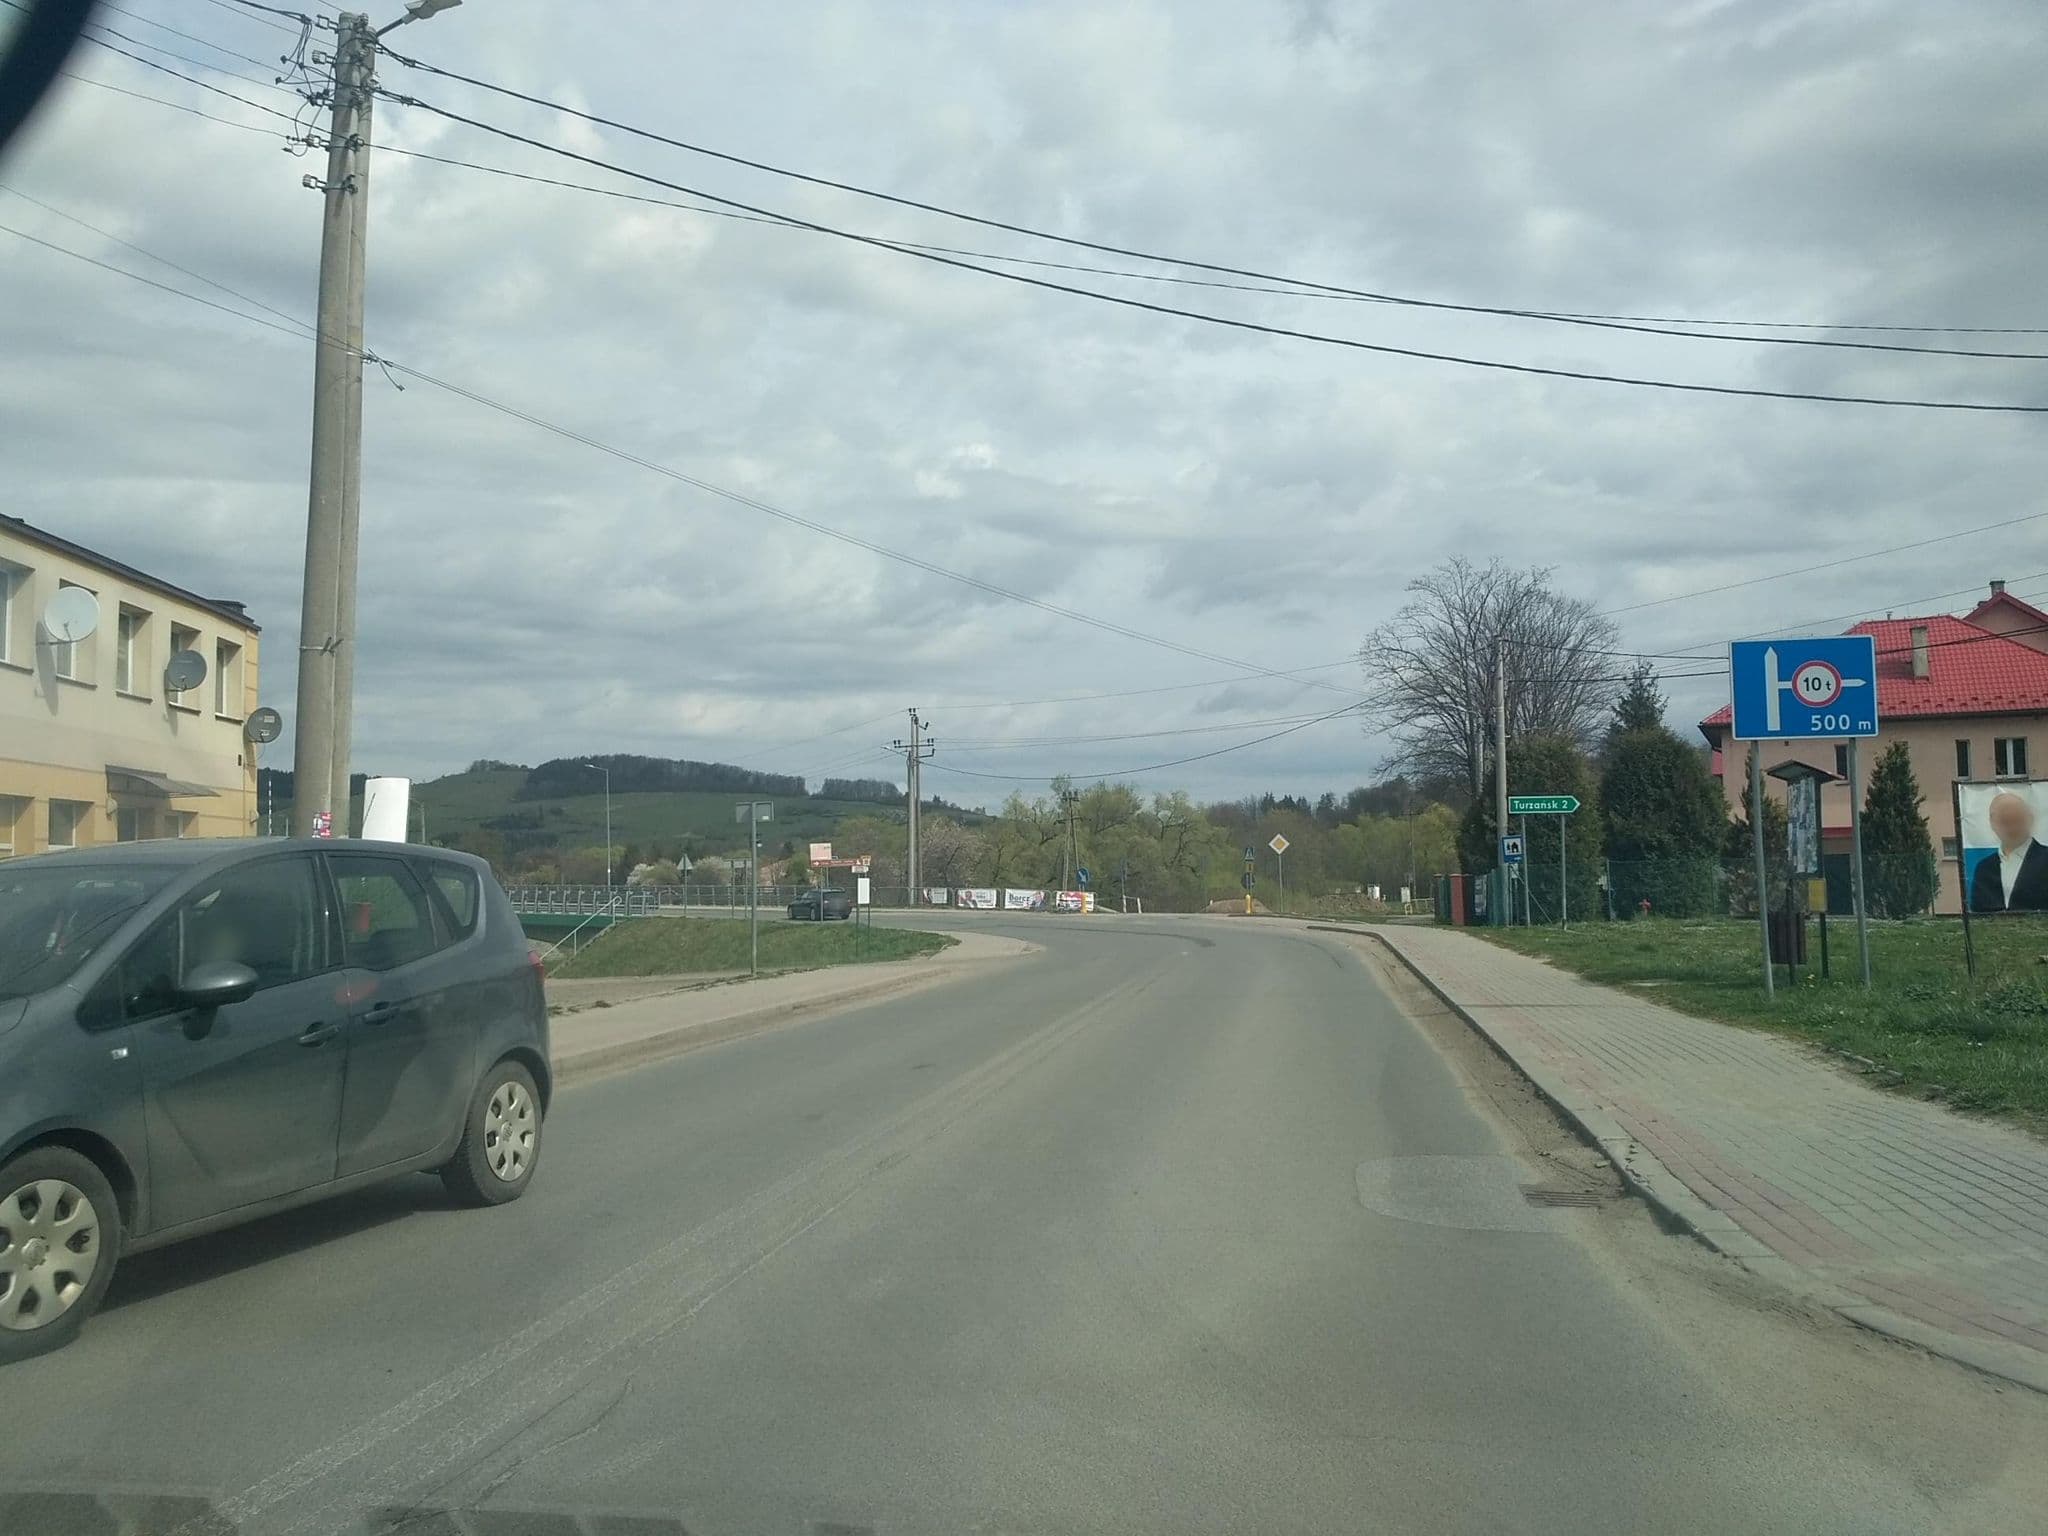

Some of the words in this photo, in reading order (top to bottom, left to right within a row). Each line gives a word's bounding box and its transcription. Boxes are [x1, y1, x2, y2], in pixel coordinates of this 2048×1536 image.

[1804, 677, 1821, 691] 10
[1825, 680, 1831, 691] t
[1811, 714, 1850, 731] 500
[1858, 720, 1871, 730] m
[1562, 800, 1568, 809] 2
